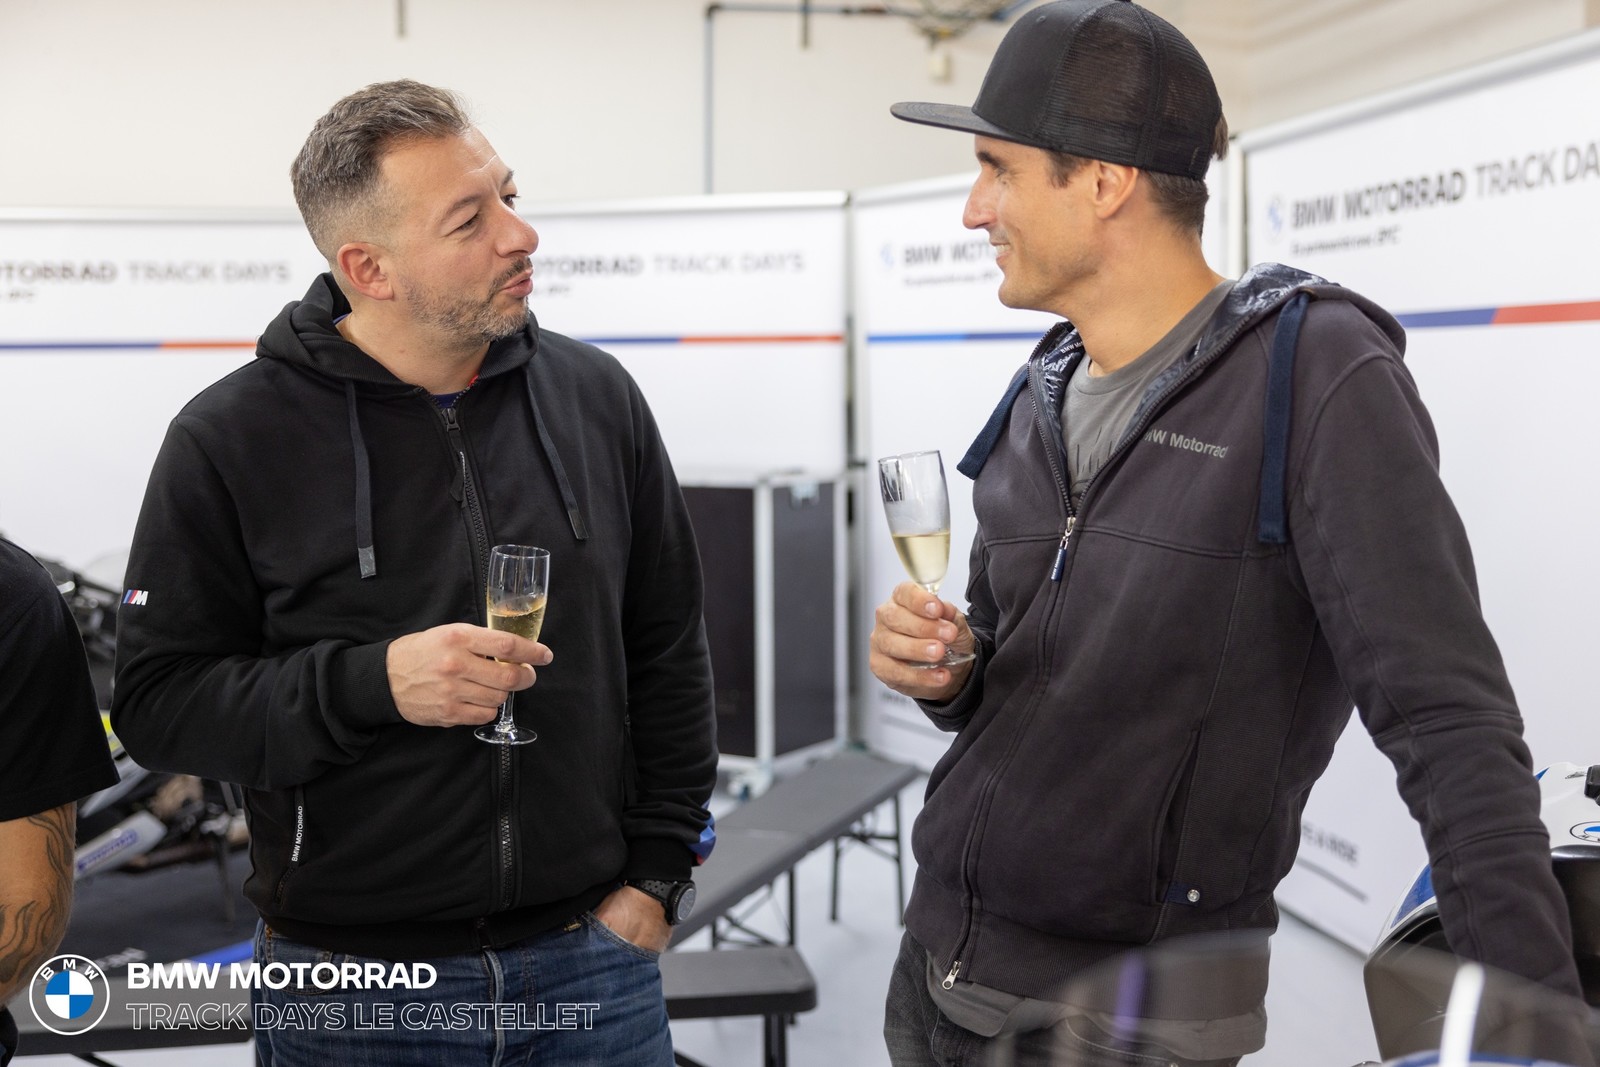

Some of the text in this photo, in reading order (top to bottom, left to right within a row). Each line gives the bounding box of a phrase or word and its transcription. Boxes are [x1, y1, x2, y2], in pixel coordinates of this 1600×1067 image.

[1343, 170, 1467, 220] MOTORRAD
[1475, 152, 1556, 198] TRACK
[1169, 432, 1229, 459] Motorrad
[291, 805, 304, 862] BMW MOTORRAD
